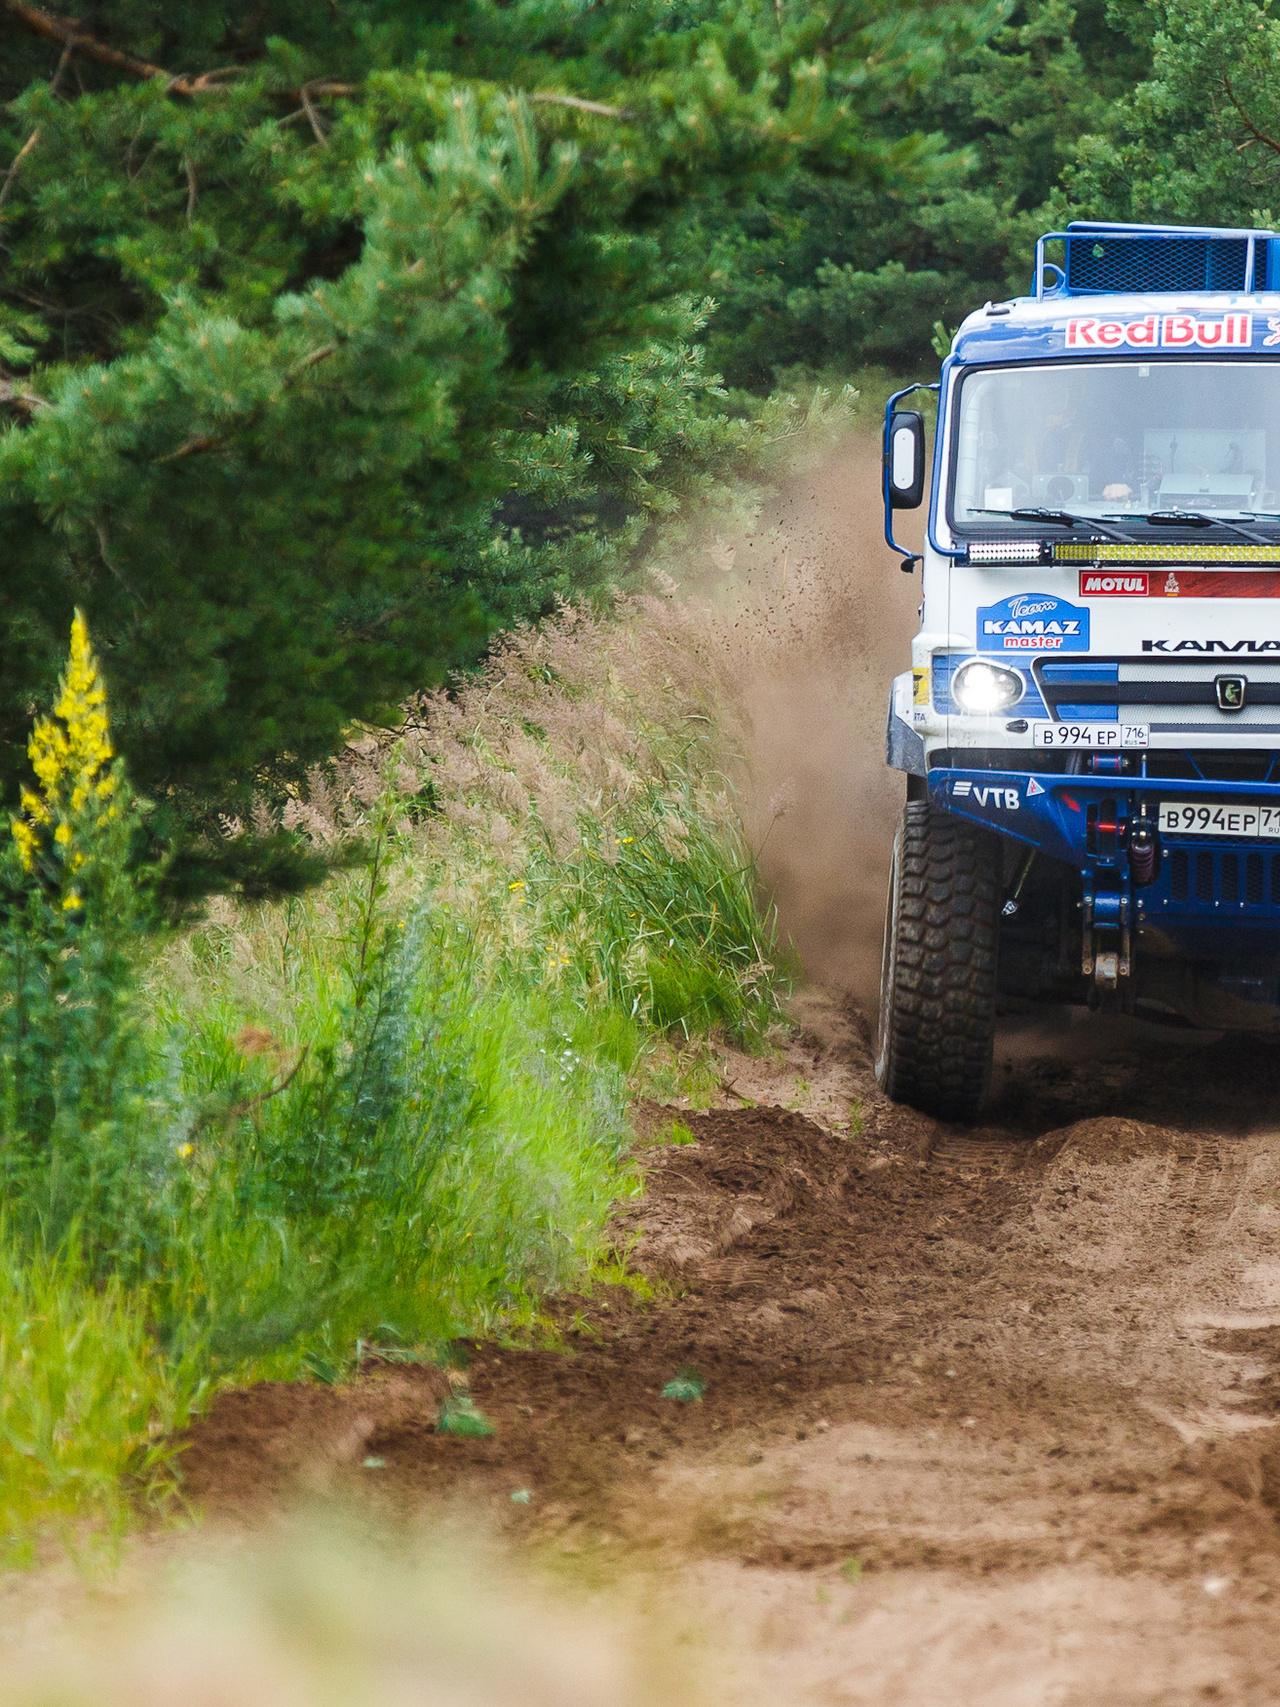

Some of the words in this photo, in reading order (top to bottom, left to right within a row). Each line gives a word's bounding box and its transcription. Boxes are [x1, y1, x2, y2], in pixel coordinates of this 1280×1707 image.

[1067, 316, 1157, 346] Red
[1164, 315, 1249, 346] Bull
[1084, 577, 1145, 591] MOTUL
[1008, 596, 1058, 619] Team
[983, 620, 1080, 635] KAMAZ
[1004, 636, 1063, 648] master
[1058, 726, 1092, 745] 994
[1125, 727, 1145, 739] 716
[972, 786, 1020, 810] VTB
